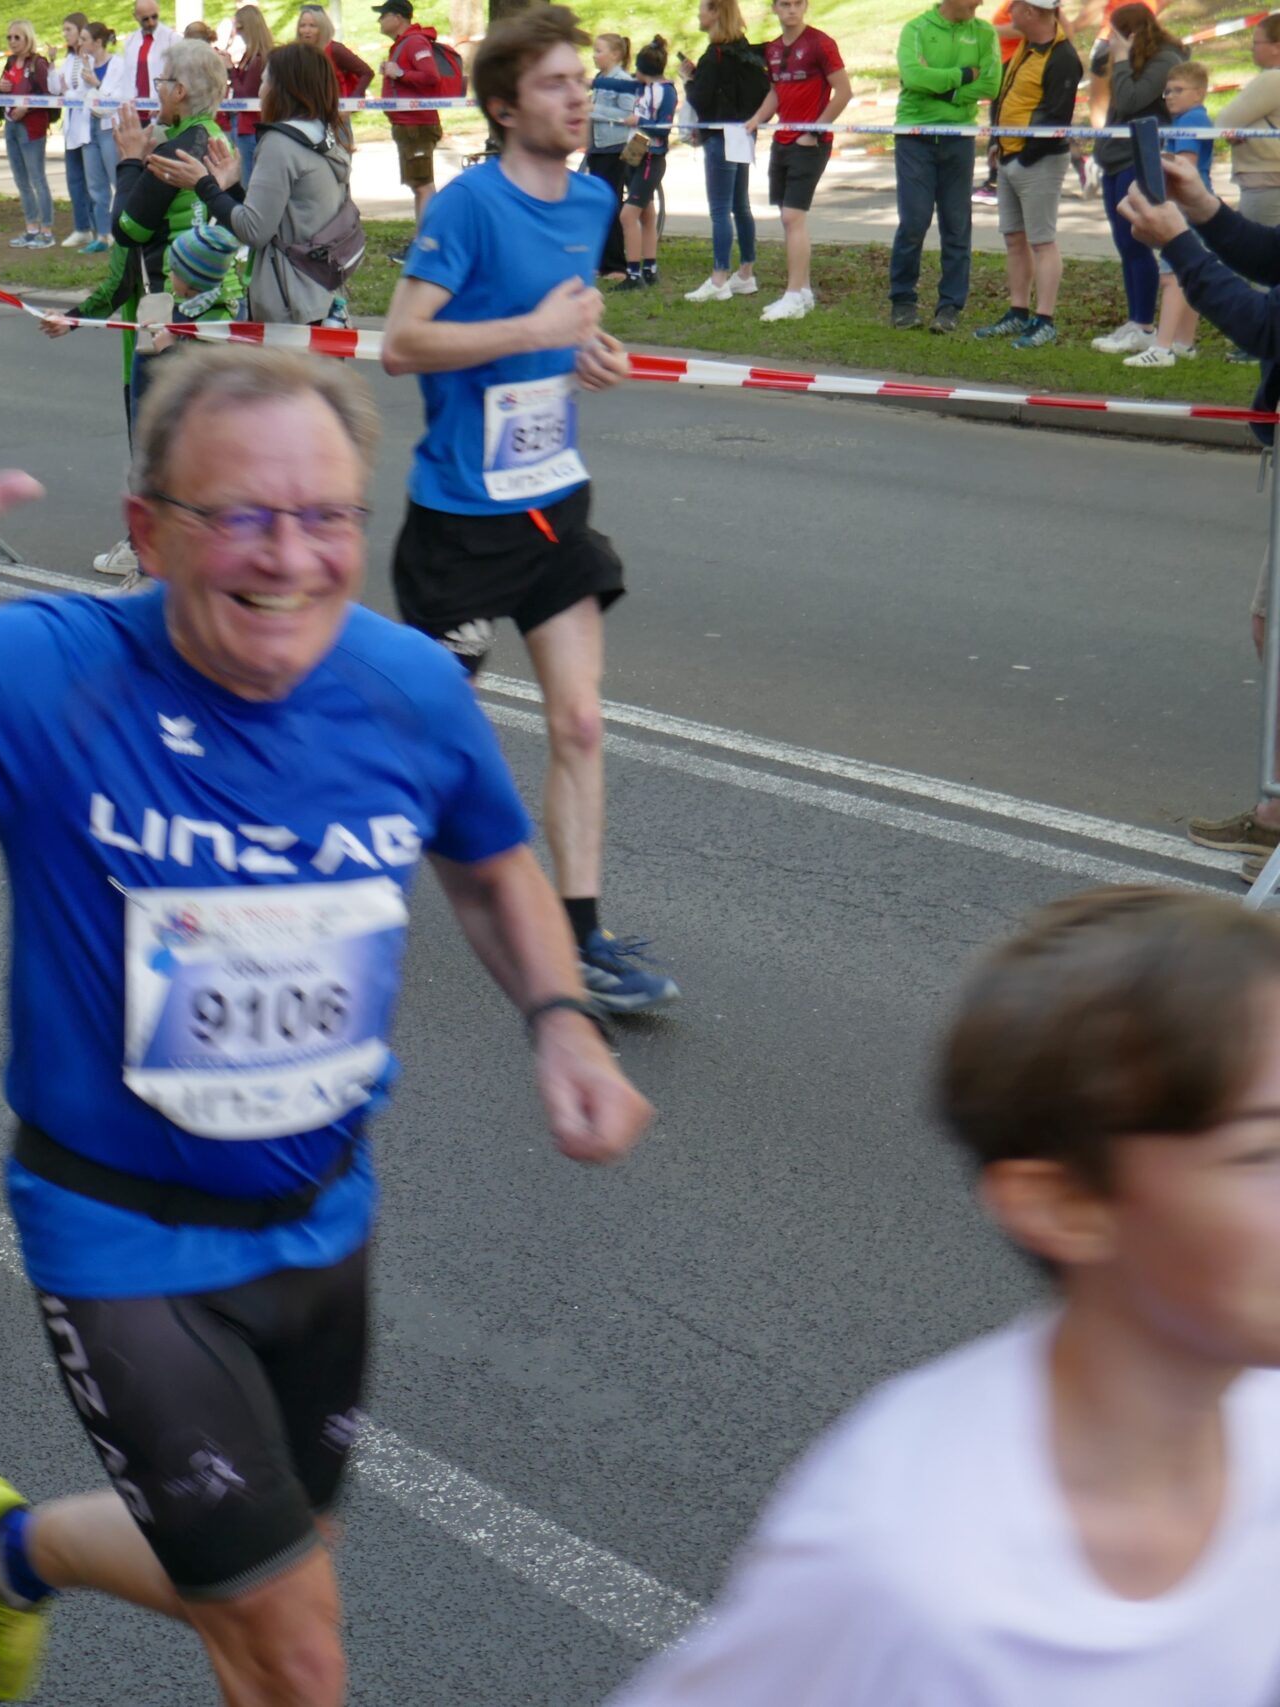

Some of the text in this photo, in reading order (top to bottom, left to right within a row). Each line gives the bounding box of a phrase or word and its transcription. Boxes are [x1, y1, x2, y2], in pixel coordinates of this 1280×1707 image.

[90, 792, 422, 875] LINZ AG
[186, 980, 352, 1045] 9106
